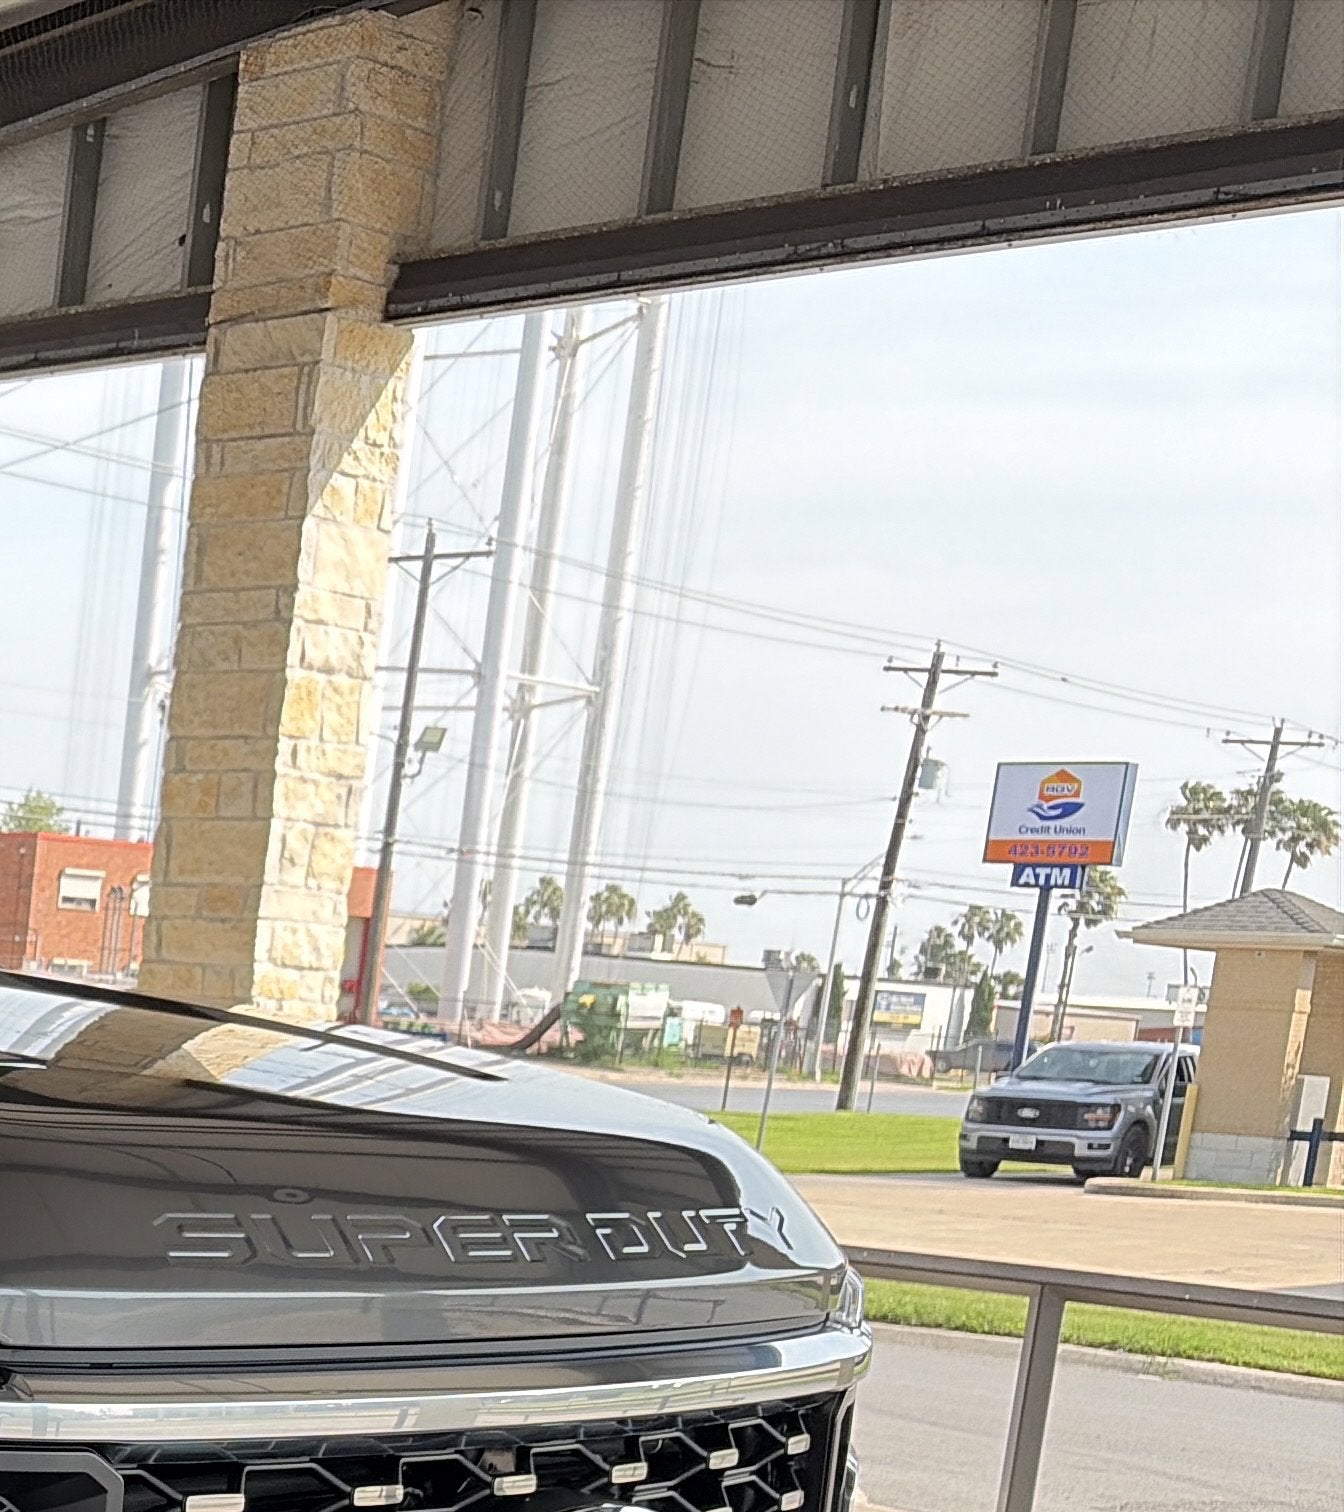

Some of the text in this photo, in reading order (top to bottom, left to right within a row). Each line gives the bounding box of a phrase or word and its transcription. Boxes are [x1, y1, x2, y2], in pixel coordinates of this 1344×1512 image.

[1018, 824, 1086, 836] Credit Union
[1018, 866, 1072, 887] ATM
[153, 1212, 591, 1265] SUPER
